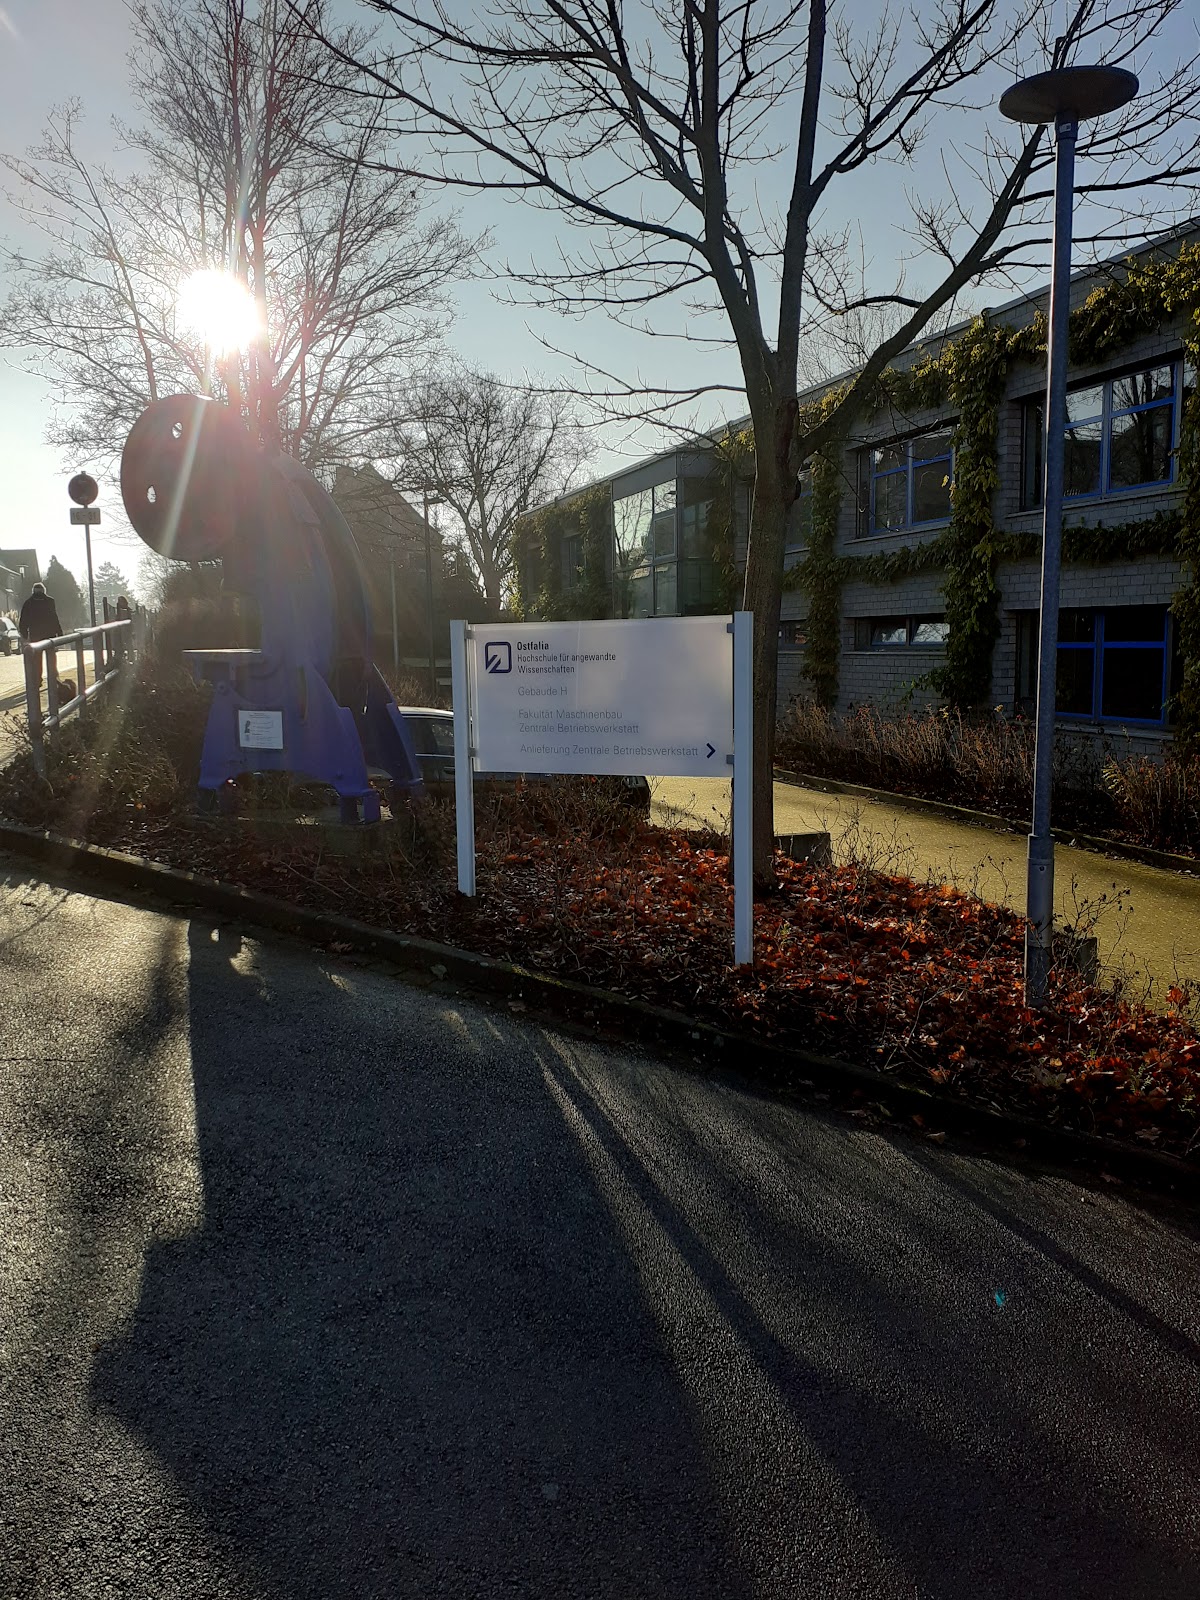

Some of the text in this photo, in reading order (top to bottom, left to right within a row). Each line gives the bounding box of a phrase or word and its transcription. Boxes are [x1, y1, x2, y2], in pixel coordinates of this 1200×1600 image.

[516, 641, 549, 651] Ostfalia
[517, 652, 616, 663] Hochschule für angewandte
[517, 665, 575, 674] Wissenschaften
[560, 686, 568, 696] H
[556, 709, 623, 720] Maschinenbau
[519, 723, 639, 733] Zentrale Betriebswerkstatt
[520, 744, 699, 756] Anlieferung Zentrale Betriebswerkstatt
